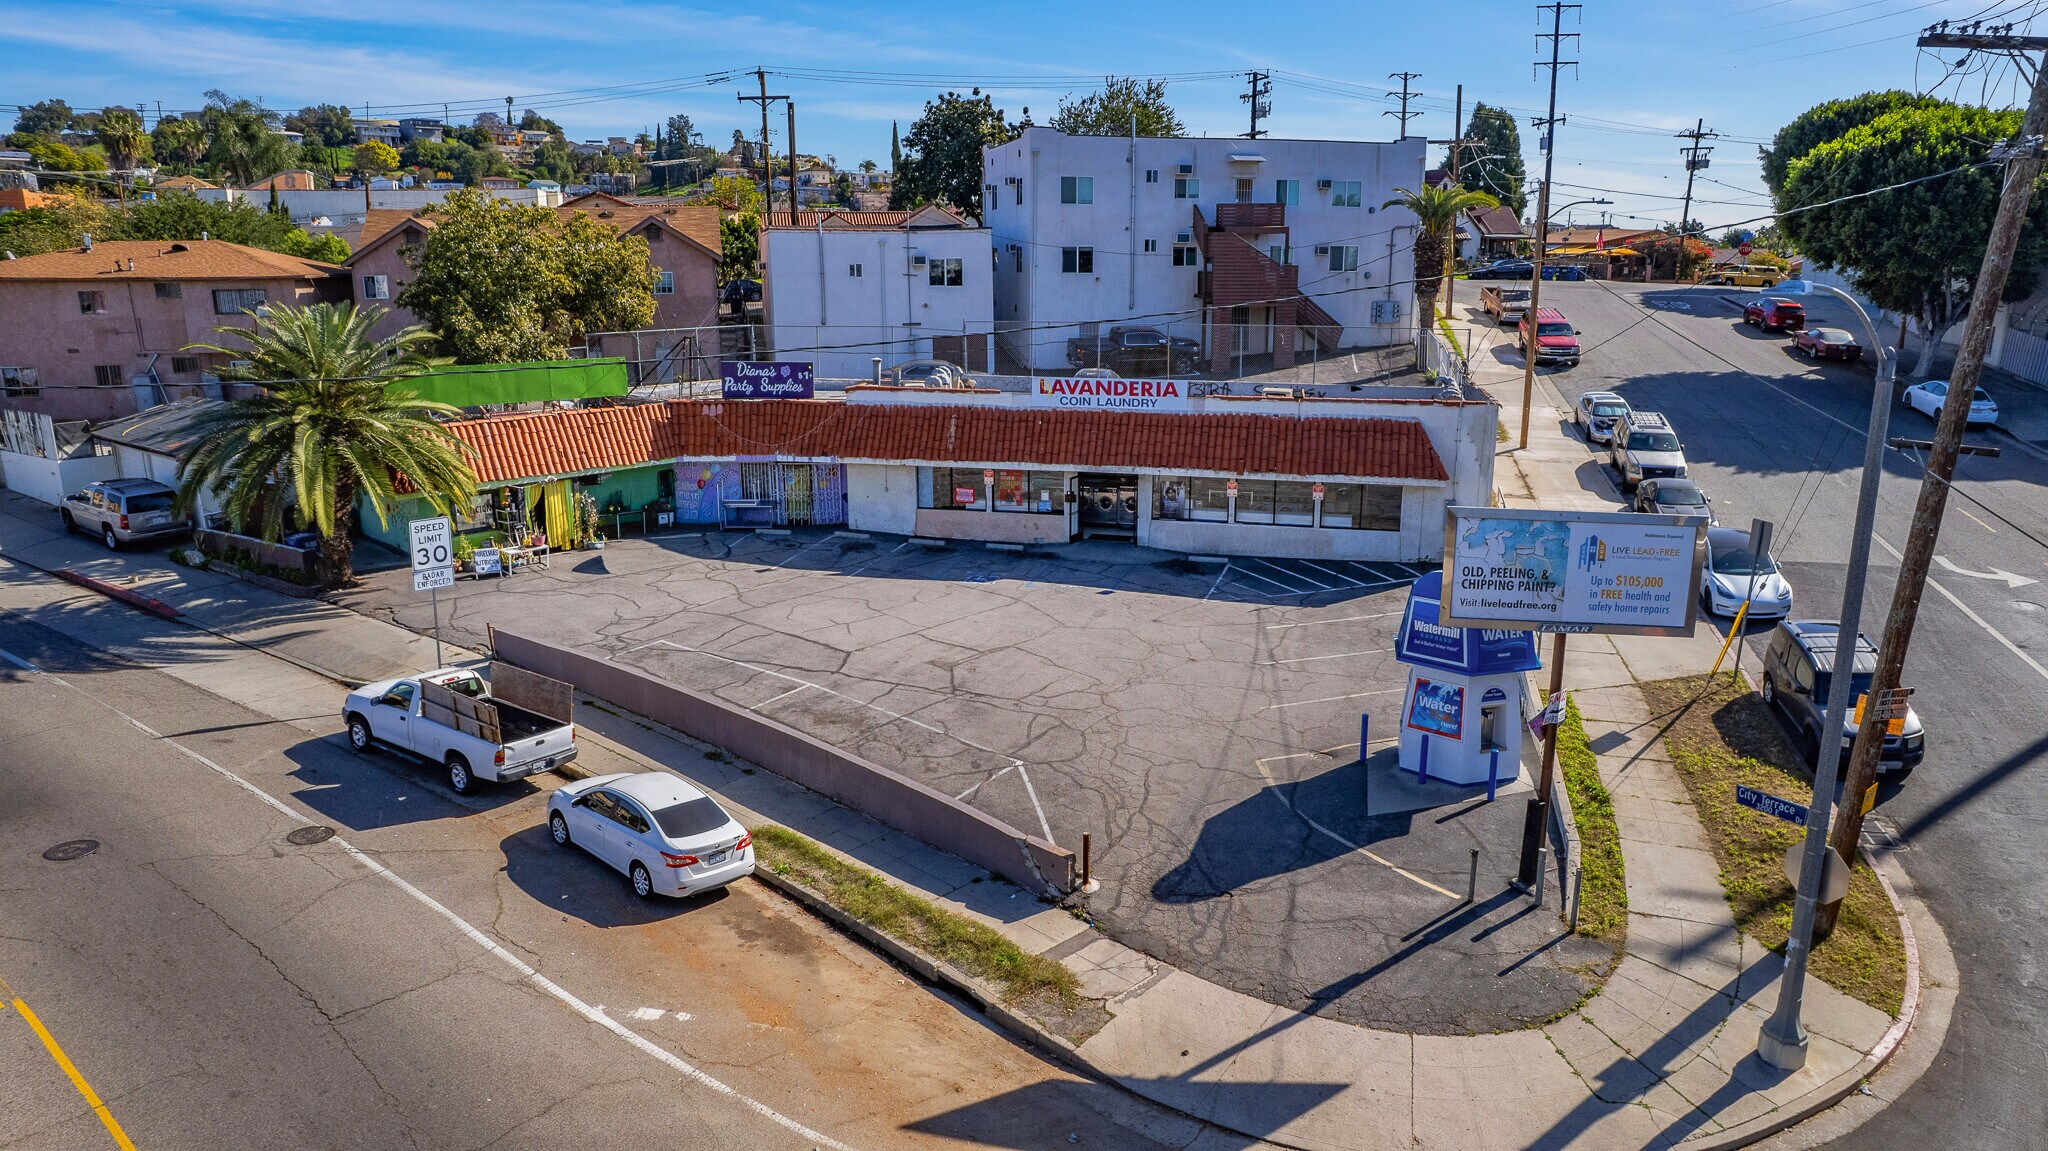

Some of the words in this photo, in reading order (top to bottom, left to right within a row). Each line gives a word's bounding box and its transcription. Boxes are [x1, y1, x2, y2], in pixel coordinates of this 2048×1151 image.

[736, 362, 777, 377] Diana's
[724, 376, 754, 395] Party
[760, 377, 804, 395] Supplies
[1039, 378, 1179, 397] LAVANDERIA
[1059, 396, 1091, 406] COIN
[1096, 397, 1158, 408] LAUNDRY
[414, 522, 445, 534] SPEED
[418, 533, 442, 545] LIMIT
[416, 545, 448, 566] 30
[1611, 546, 1630, 555] LIVE
[1632, 547, 1681, 557] LEAD-FREE
[1462, 566, 1487, 579] OLD,
[1490, 567, 1538, 580] PEELING,
[1541, 569, 1549, 580] &
[417, 577, 451, 588] ENFORCED
[1461, 578, 1516, 591] CHIPPING
[1518, 580, 1556, 593] PAINT?
[1590, 576, 1603, 587] Up
[1604, 577, 1613, 586] to
[1615, 575, 1664, 588] $105,000
[1589, 590, 1598, 599] in
[1601, 590, 1622, 600] FREE
[1625, 590, 1652, 601] health
[1654, 591, 1671, 602] and
[1588, 602, 1613, 614] safety
[1615, 602, 1639, 613] home
[1640, 604, 1670, 615] repairs
[1414, 619, 1460, 639] Watermill
[1481, 629, 1525, 642] WATER
[1540, 625, 1590, 633] LAMAR
[1420, 632, 1453, 644] EXPRESS
[1418, 695, 1458, 714] Water
[1440, 721, 1458, 730] Here!
[1738, 787, 1758, 804] City
[1761, 794, 1796, 815] Terrace
[1755, 802, 1773, 814] 3200
[1774, 809, 1779, 817] E
[1795, 816, 1803, 824] Dr
